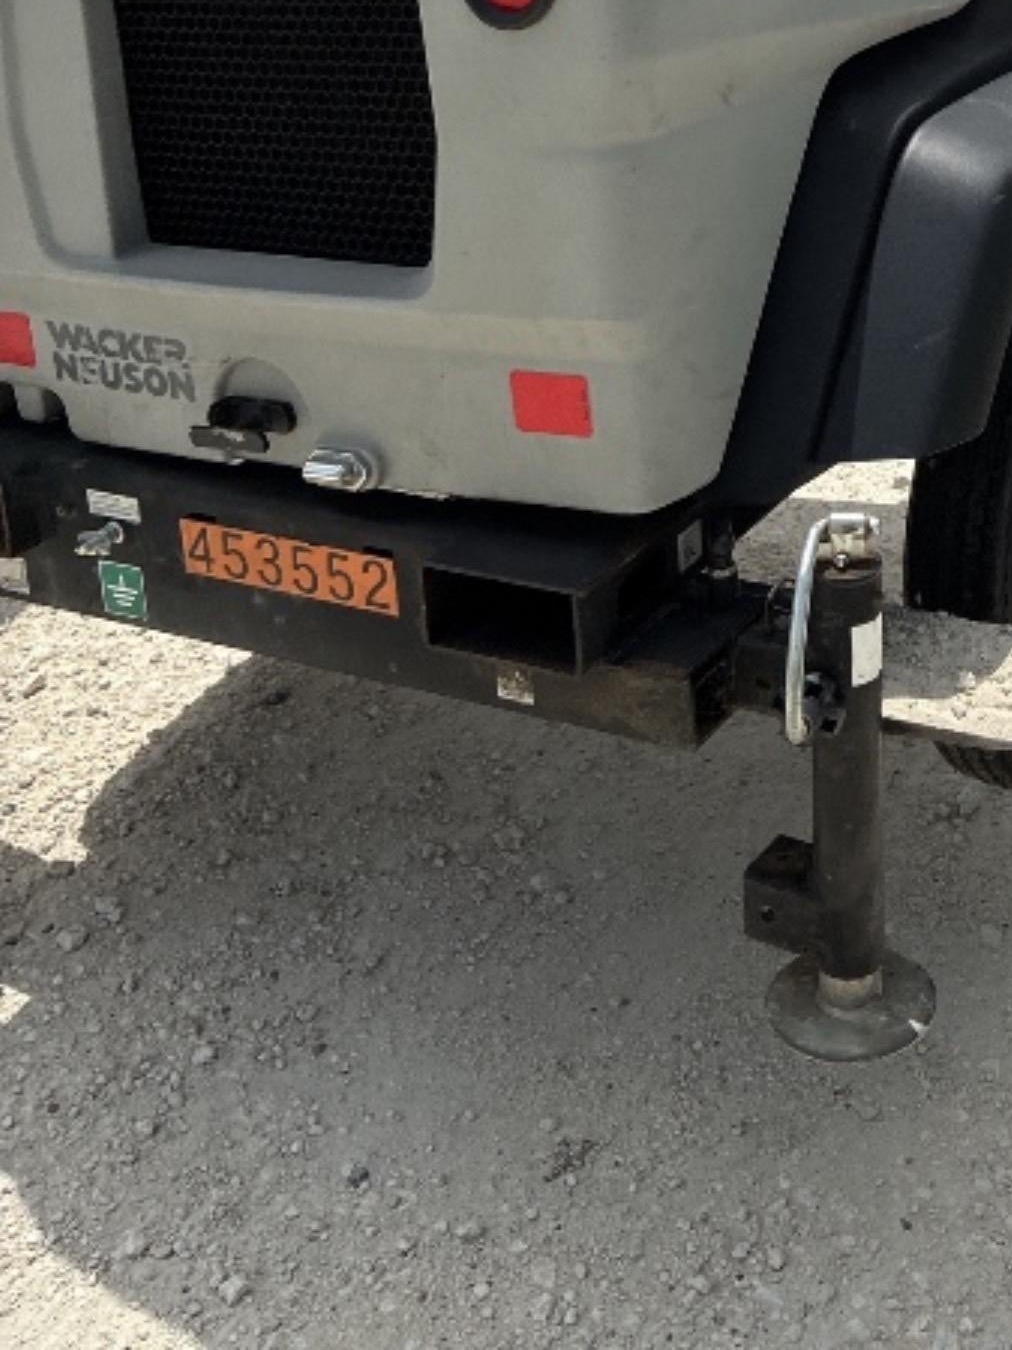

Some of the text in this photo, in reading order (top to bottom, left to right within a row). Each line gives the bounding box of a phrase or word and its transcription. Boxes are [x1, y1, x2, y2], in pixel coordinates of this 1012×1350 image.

[45, 320, 190, 368] WACKER
[52, 351, 196, 403] NEUSON
[188, 527, 391, 611] 453552
